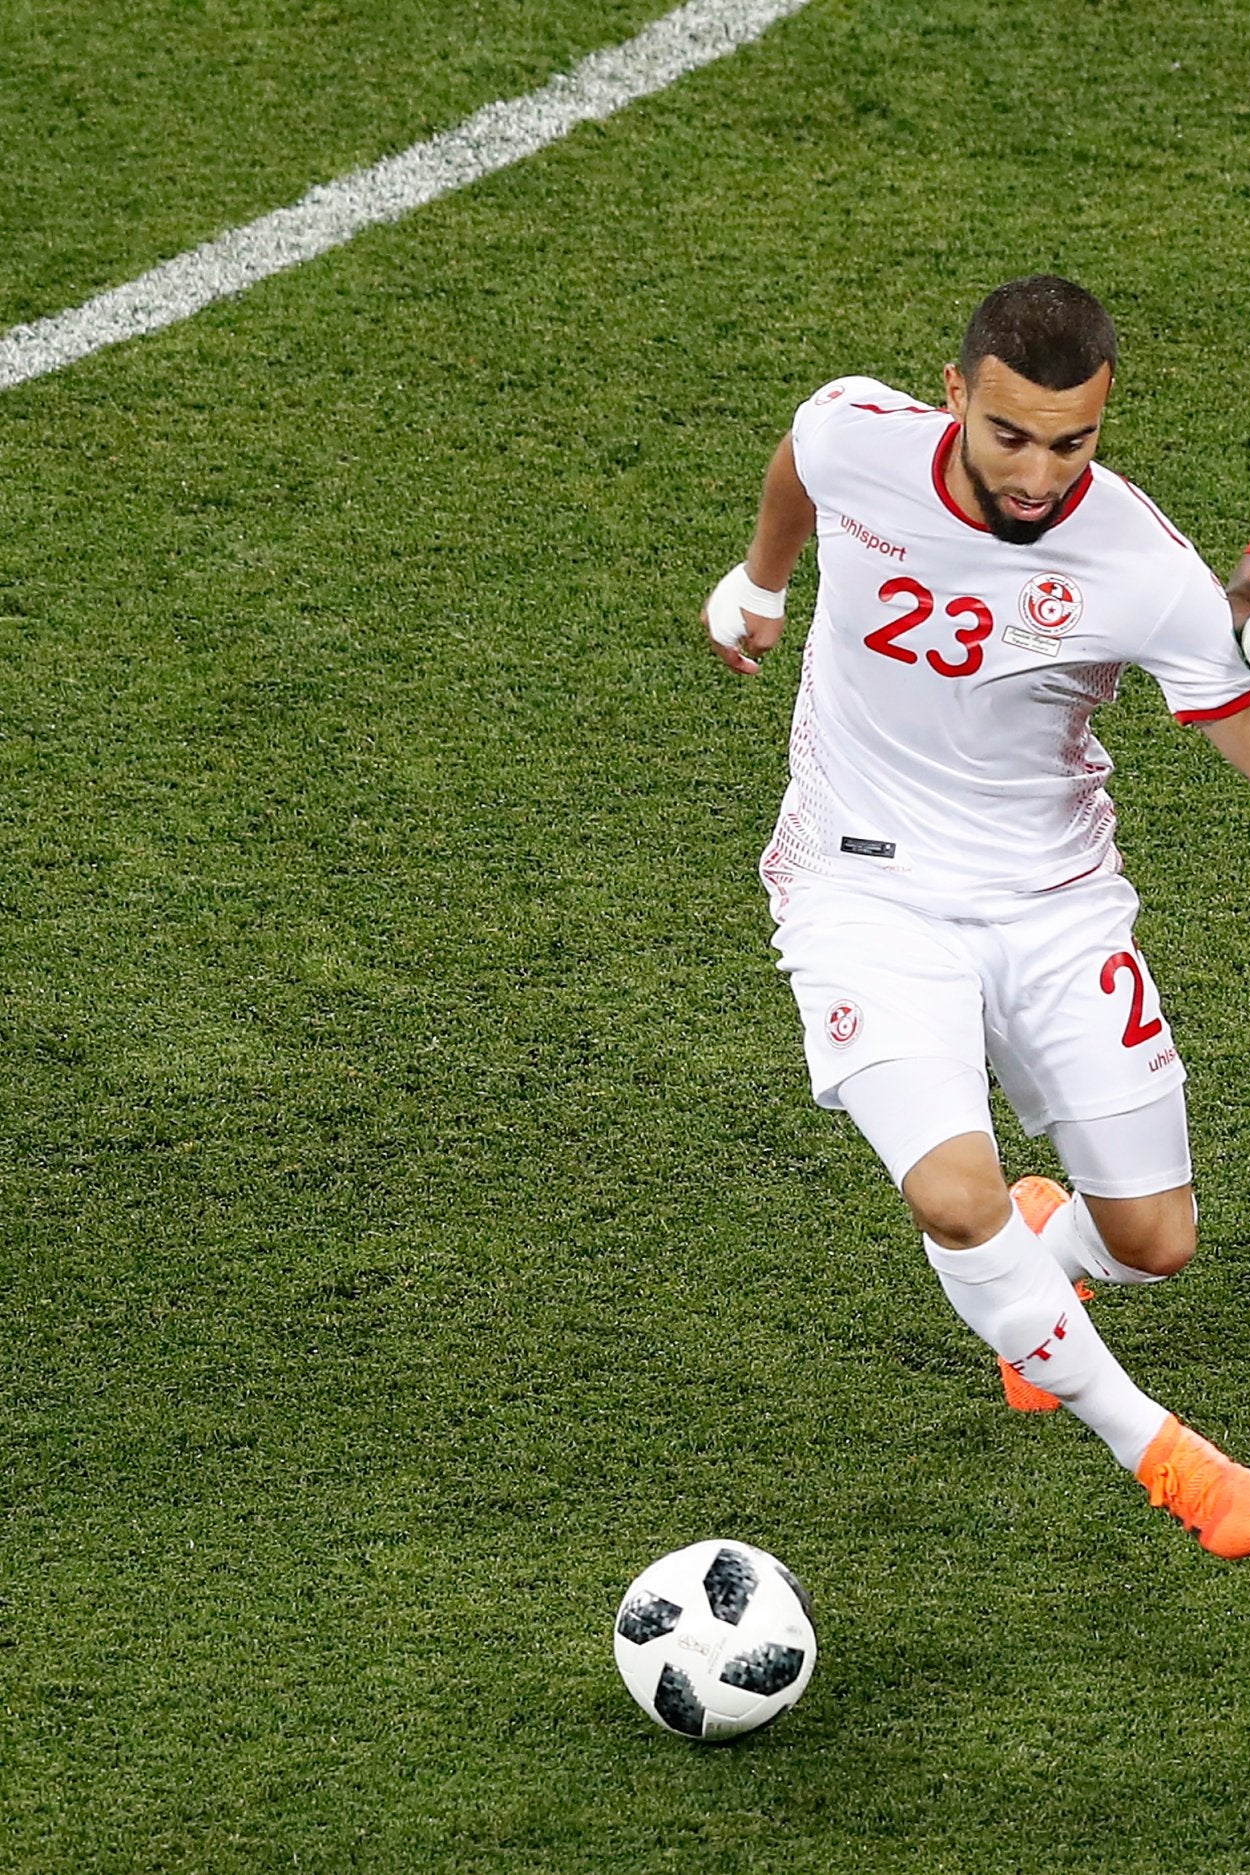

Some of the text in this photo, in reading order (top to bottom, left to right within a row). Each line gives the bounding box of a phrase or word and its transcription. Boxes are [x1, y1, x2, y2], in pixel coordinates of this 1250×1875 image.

[840, 514, 907, 562] uhlsport
[863, 576, 993, 678] 23
[1148, 1047, 1178, 1072] uhls
